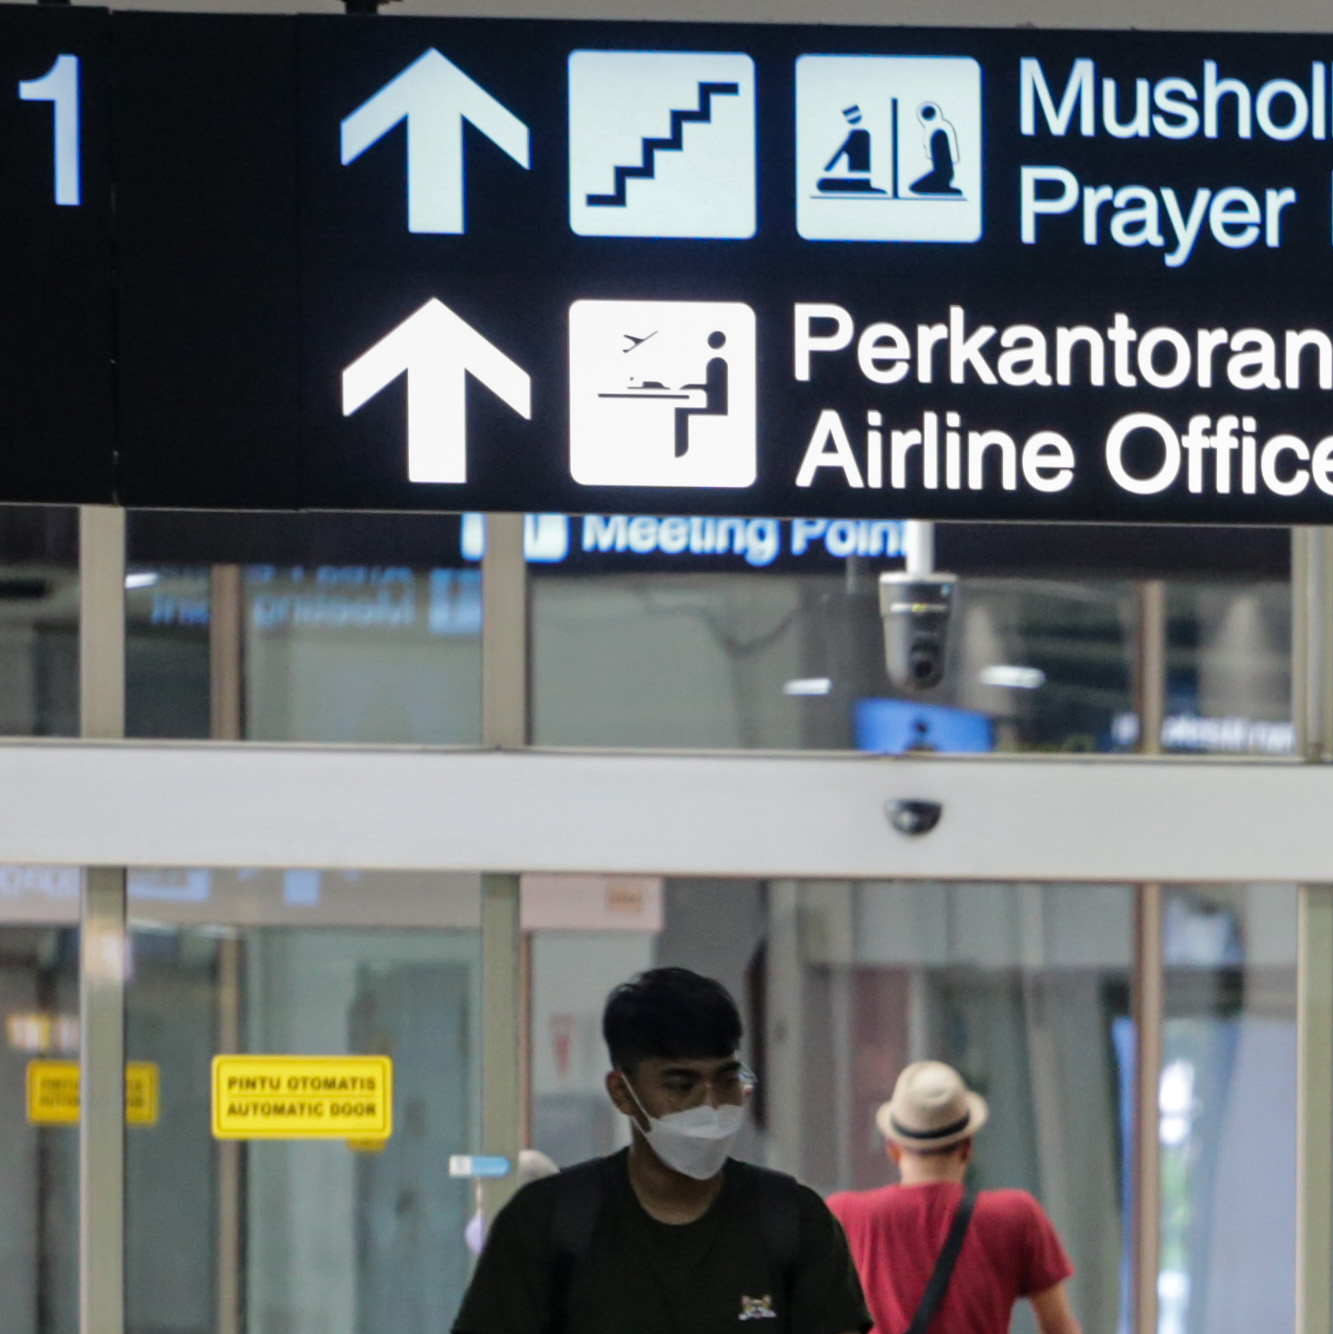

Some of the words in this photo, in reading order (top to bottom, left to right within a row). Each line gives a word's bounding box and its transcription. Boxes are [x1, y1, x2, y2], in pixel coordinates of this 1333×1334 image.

[20, 55, 79, 206] 1
[1020, 165, 1296, 267] Prayer
[793, 302, 1333, 391] Perkantoran
[795, 408, 1076, 493] Airline
[582, 513, 780, 566] Meeting
[227, 1102, 324, 1118] AUTOMATIC
[330, 1102, 377, 1118] DOOR
[228, 1075, 281, 1091] PINTU
[287, 1075, 377, 1091] OTOMATIS
